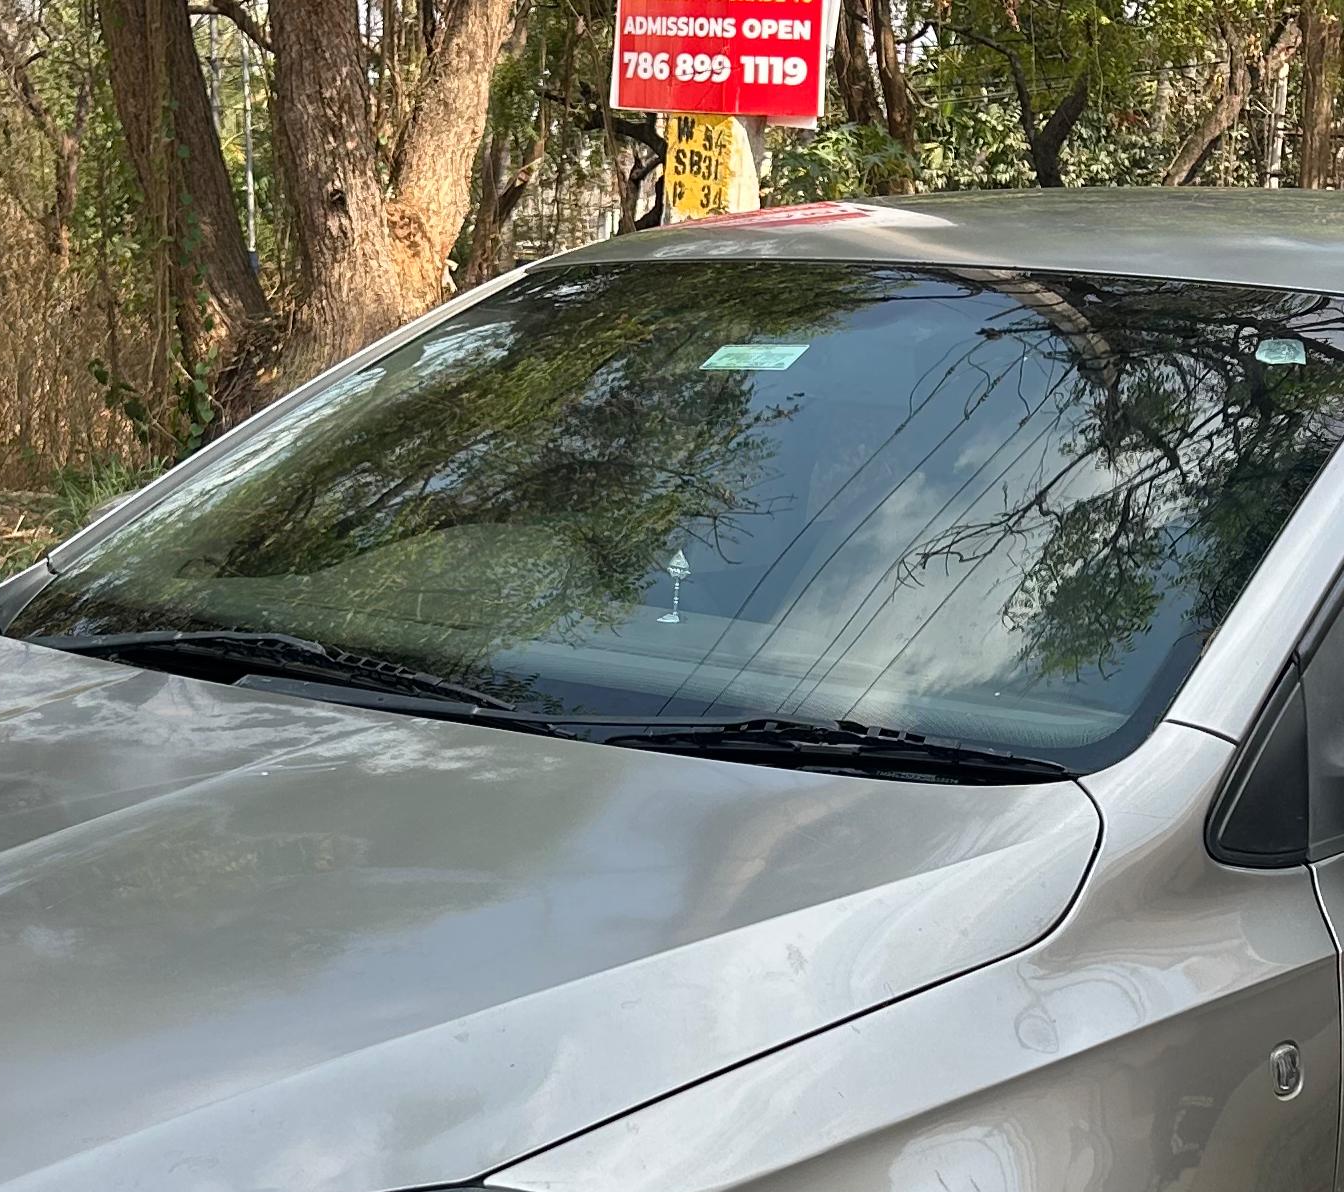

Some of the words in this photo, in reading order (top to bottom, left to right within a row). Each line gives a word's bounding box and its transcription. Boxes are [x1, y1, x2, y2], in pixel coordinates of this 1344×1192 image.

[623, 16, 737, 38] ADMISSIONS
[741, 18, 812, 40] OPEN
[623, 51, 670, 80] 786
[674, 53, 731, 83] 899
[740, 55, 808, 86] 1119
